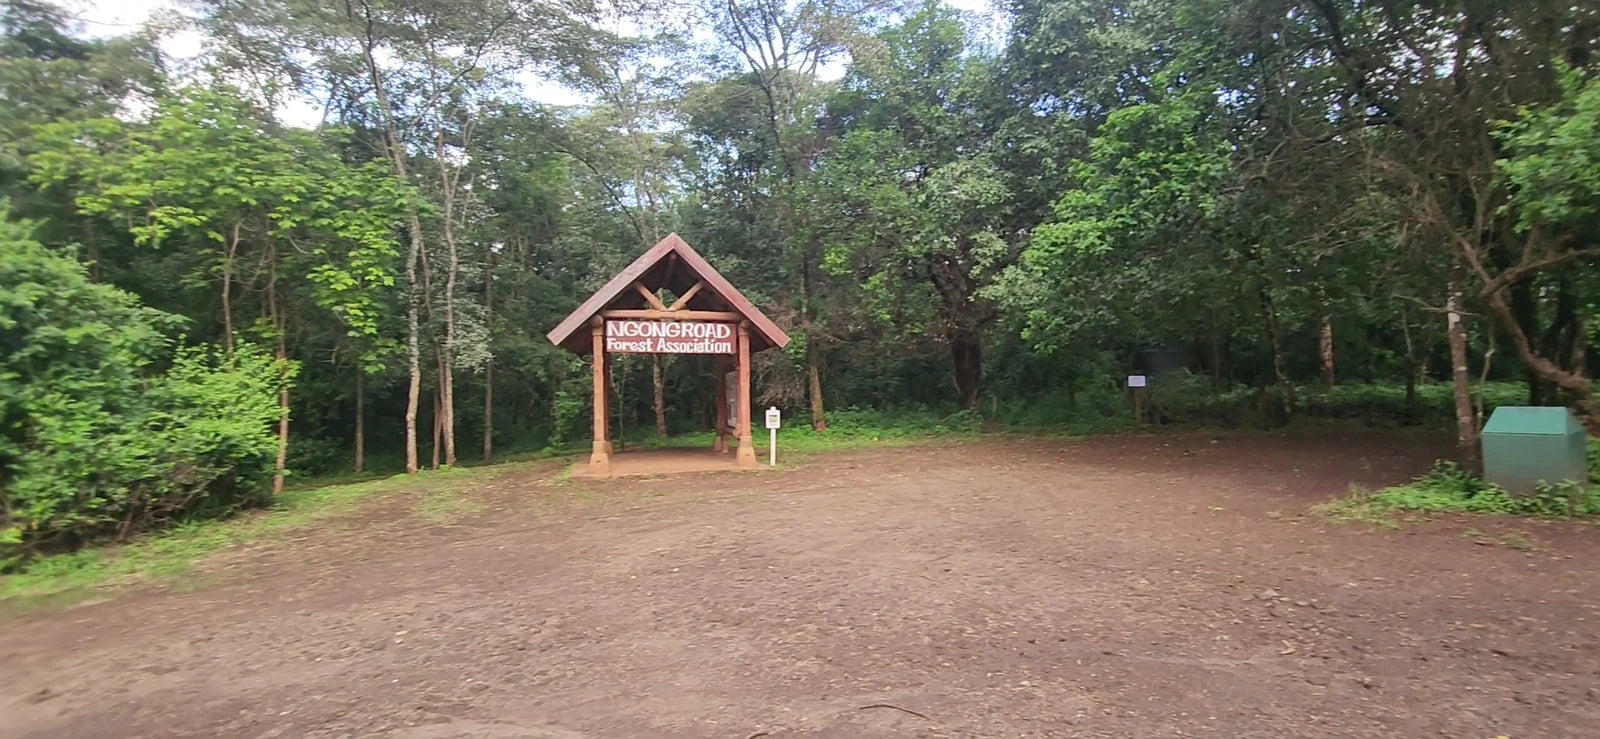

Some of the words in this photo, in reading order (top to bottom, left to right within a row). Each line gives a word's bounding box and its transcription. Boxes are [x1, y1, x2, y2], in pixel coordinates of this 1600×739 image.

[606, 320, 681, 337] NGONG
[681, 322, 731, 338] ROAD
[606, 337, 653, 352] Forest
[656, 338, 732, 353] Association
